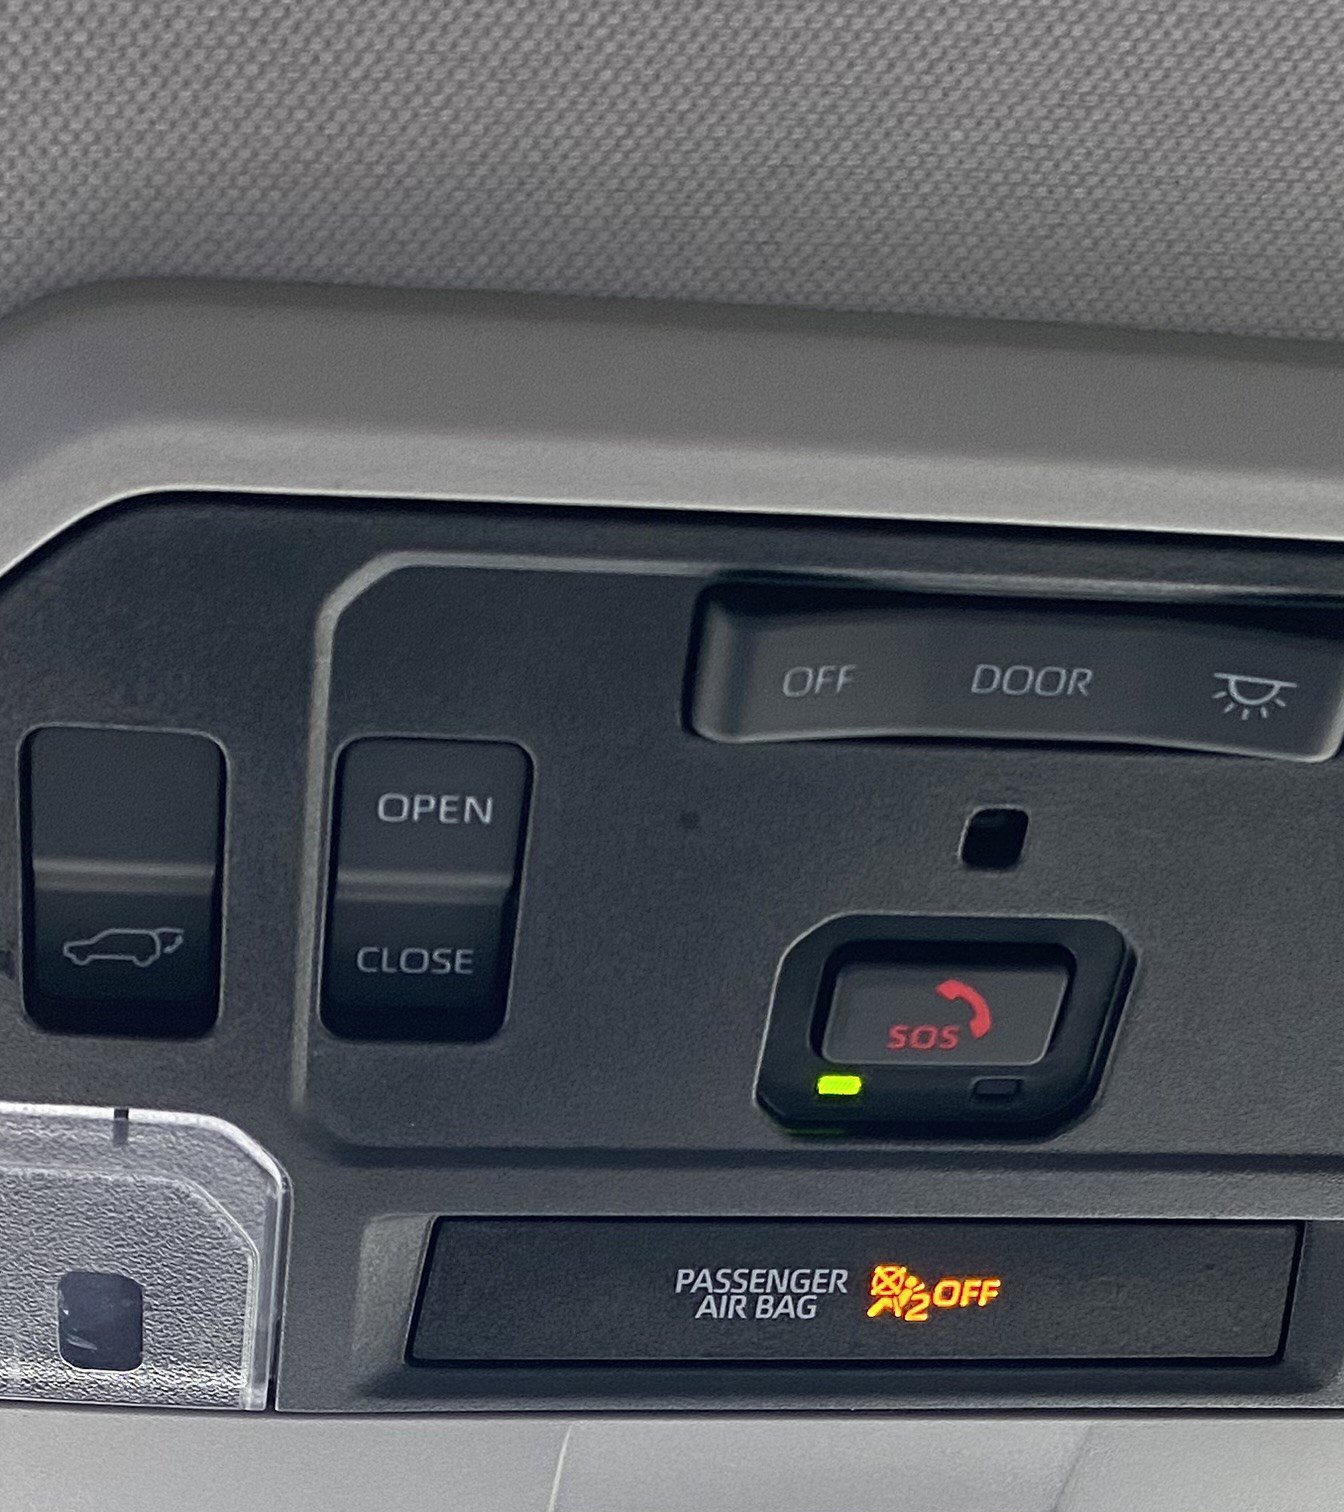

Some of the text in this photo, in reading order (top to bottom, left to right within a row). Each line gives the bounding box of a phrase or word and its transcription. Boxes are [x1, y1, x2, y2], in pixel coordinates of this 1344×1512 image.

[783, 665, 855, 698] OFF
[971, 664, 1093, 697] DOOR
[377, 792, 494, 825] OPEN
[356, 945, 474, 976] CLOSE
[886, 1024, 960, 1051] SOS
[674, 1268, 849, 1294] PASSENGER
[933, 1278, 1002, 1308] OFF
[694, 1294, 818, 1320] AIR BAG
